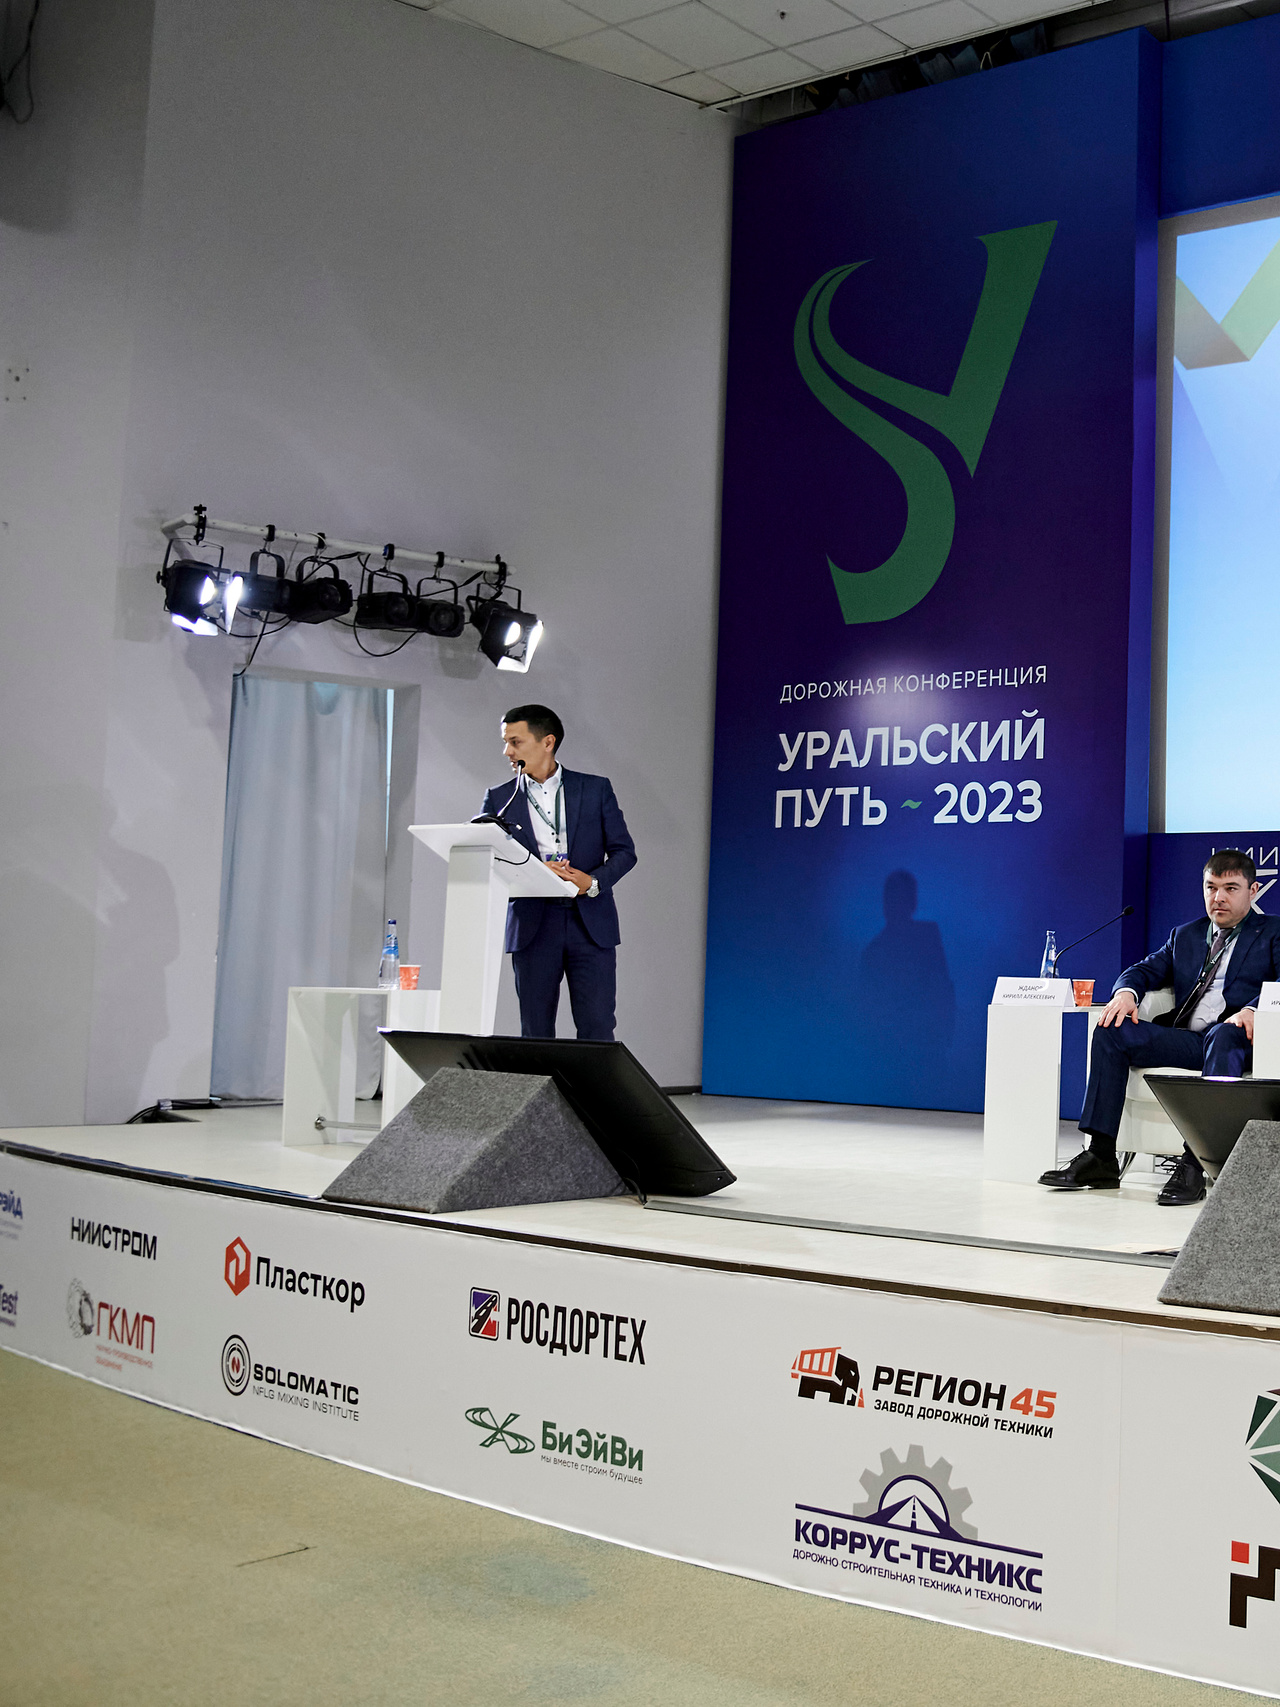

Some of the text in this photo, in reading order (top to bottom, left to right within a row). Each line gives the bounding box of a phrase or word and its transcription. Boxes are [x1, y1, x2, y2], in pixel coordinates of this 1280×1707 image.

[779, 665, 1047, 704] ДОРОЖНАЯ КОНФЕРЕНЦИЯ
[777, 708, 1045, 772] УРАЛЬСКИЙ
[774, 779, 1043, 829] ПУТЬ 2023
[71, 1216, 157, 1261] НИИСТРОМ
[256, 1256, 366, 1313] Пласткор
[97, 1301, 155, 1354] ГКМП
[506, 1297, 647, 1366] РОСДОРТЕХ
[253, 1363, 360, 1405] SOLOMATIC
[253, 1385, 360, 1422] NFLG MIXING INSTITUTE
[871, 1365, 1057, 1419] РЕГИОН 45
[874, 1398, 1054, 1439] ЗАВОД ДОРОЖНОЙ ТЕХНИКИ
[541, 1420, 644, 1472] БиЭйВи
[553, 1456, 579, 1470] вместе
[580, 1463, 608, 1479] строим
[609, 1468, 643, 1485] будущее
[792, 1548, 1043, 1613] ДОРОЖНО СТРОИТЕЛЬНАЯ ТЕХНИКА И ТЕХНОЛОГИИ
[795, 1518, 1043, 1595] КОРРУС-ТЕХНИКС
